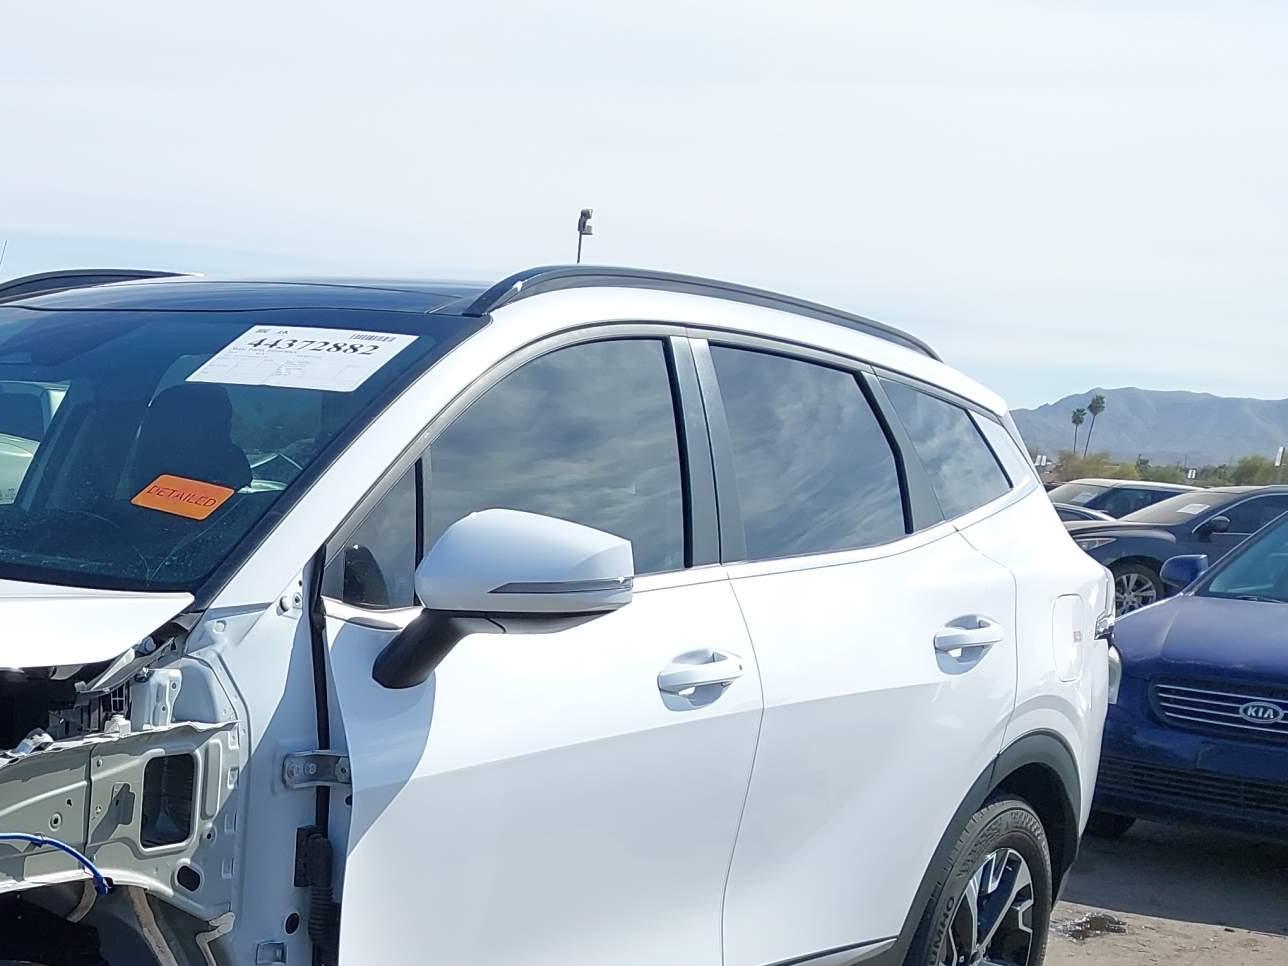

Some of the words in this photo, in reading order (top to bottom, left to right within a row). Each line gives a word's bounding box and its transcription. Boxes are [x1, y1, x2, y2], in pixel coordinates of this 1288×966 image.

[247, 337, 381, 356] 44372882
[146, 485, 217, 507] DETAILED
[1247, 705, 1274, 719] KIA
